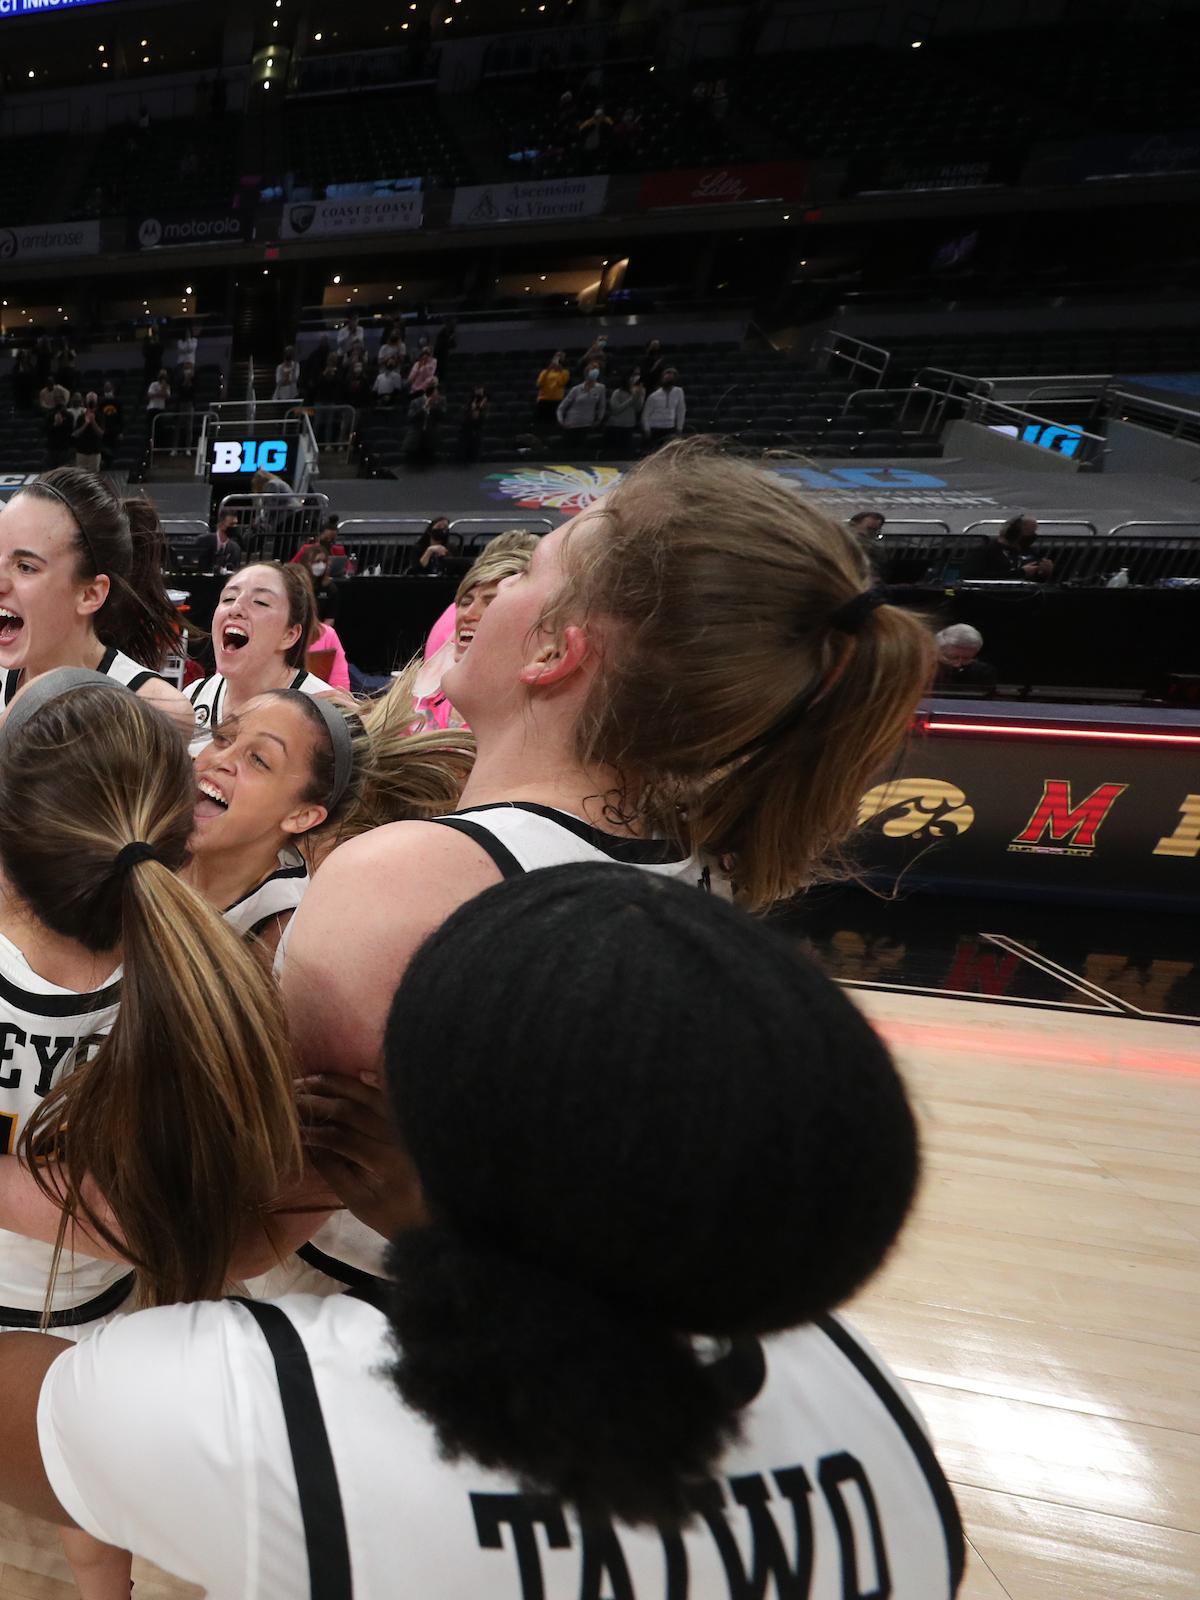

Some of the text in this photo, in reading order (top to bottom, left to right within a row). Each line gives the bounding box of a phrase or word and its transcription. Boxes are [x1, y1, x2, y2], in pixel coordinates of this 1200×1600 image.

[508, 181, 586, 199] Ascension
[691, 171, 748, 201] Lilly
[322, 206, 361, 218] COAST
[374, 201, 416, 214] COAST
[527, 201, 585, 216] Vincent
[164, 217, 241, 238] motorola
[21, 229, 84, 249] ambrose
